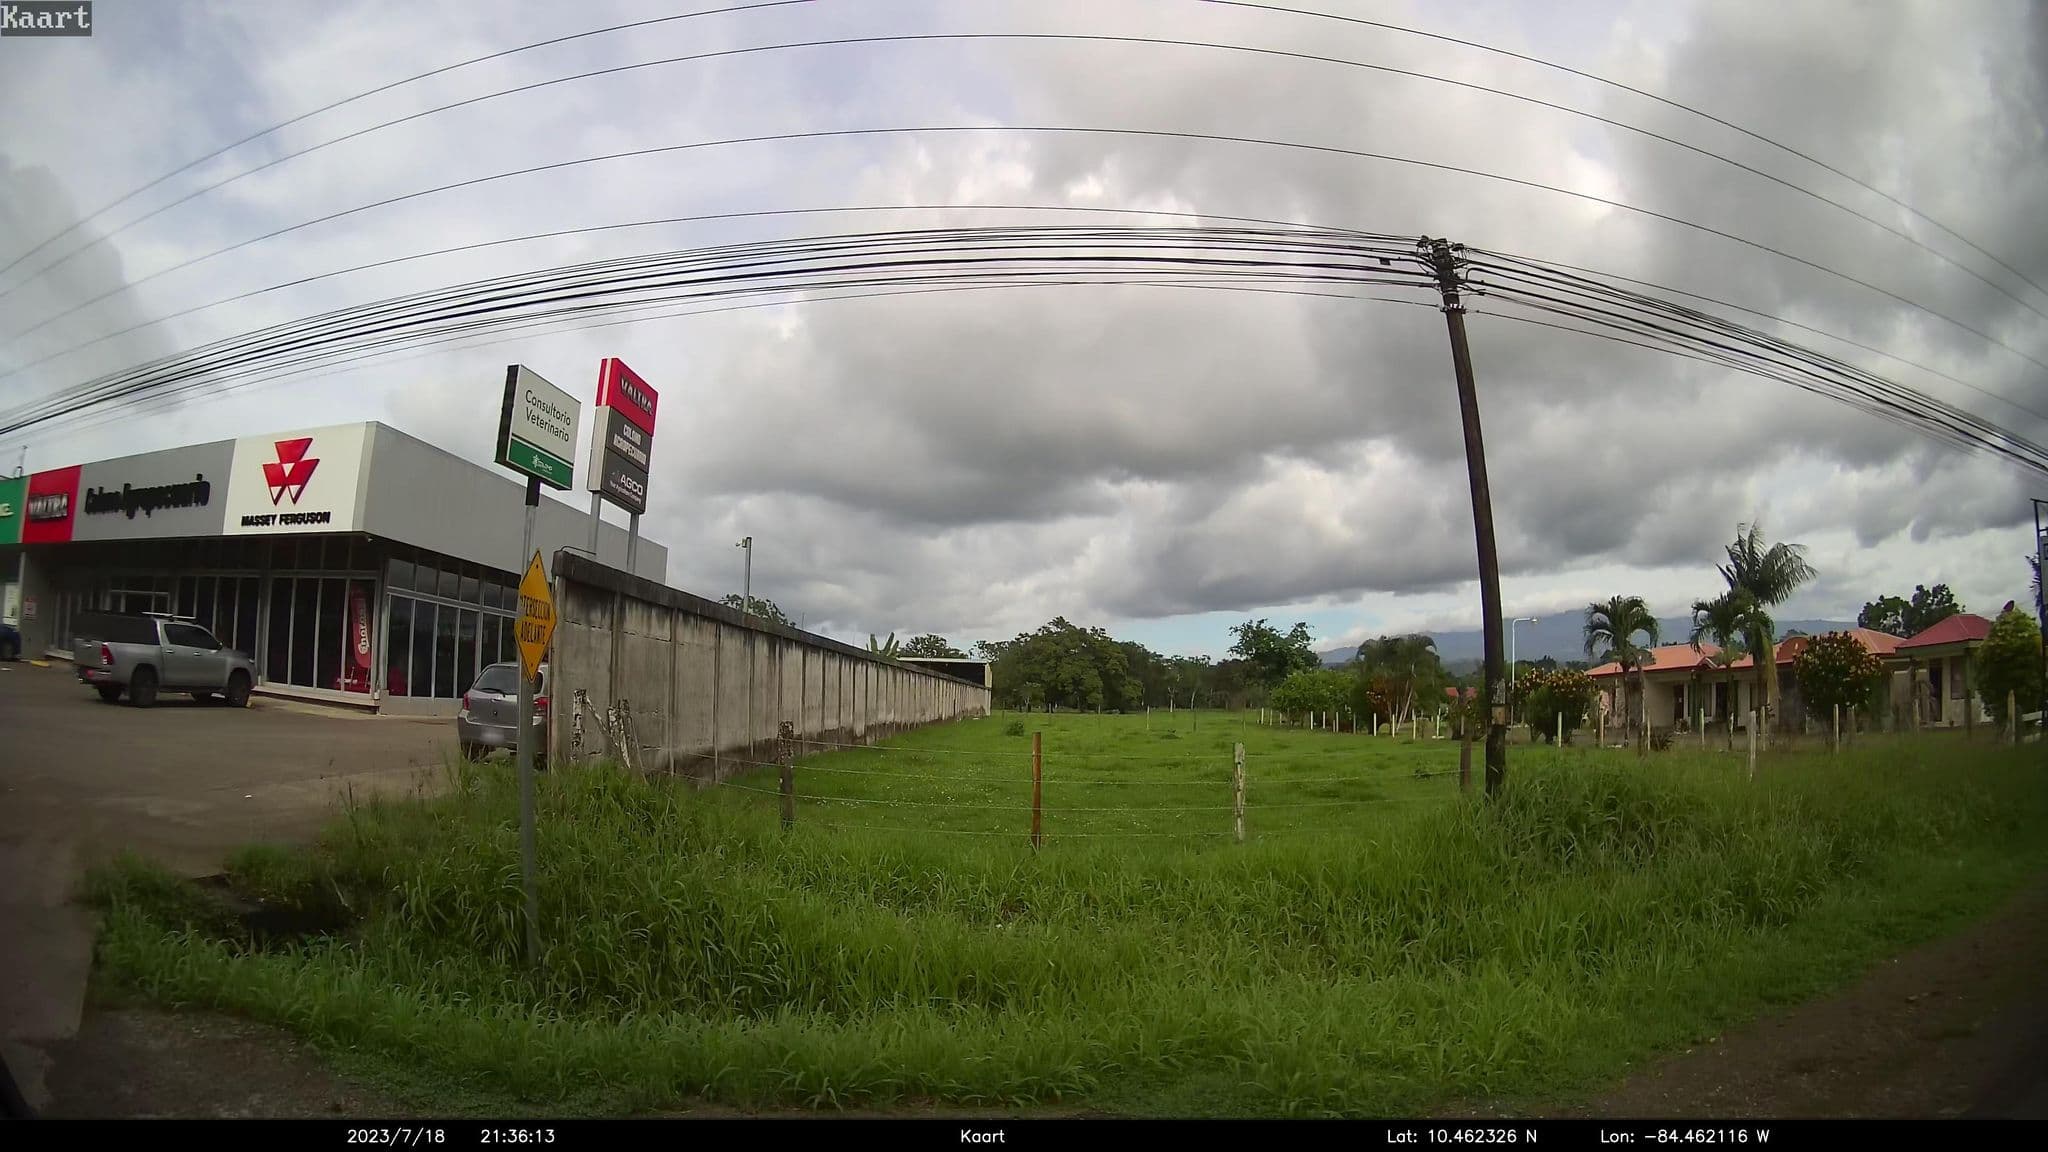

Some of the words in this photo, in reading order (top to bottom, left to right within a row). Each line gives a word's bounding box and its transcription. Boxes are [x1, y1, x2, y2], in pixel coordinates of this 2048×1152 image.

[525, 389, 571, 426] Consultorio
[526, 406, 569, 442] Veterinario
[620, 474, 643, 496] AGCO
[241, 514, 278, 527] MASSEY
[279, 511, 331, 526] FERGUSON
